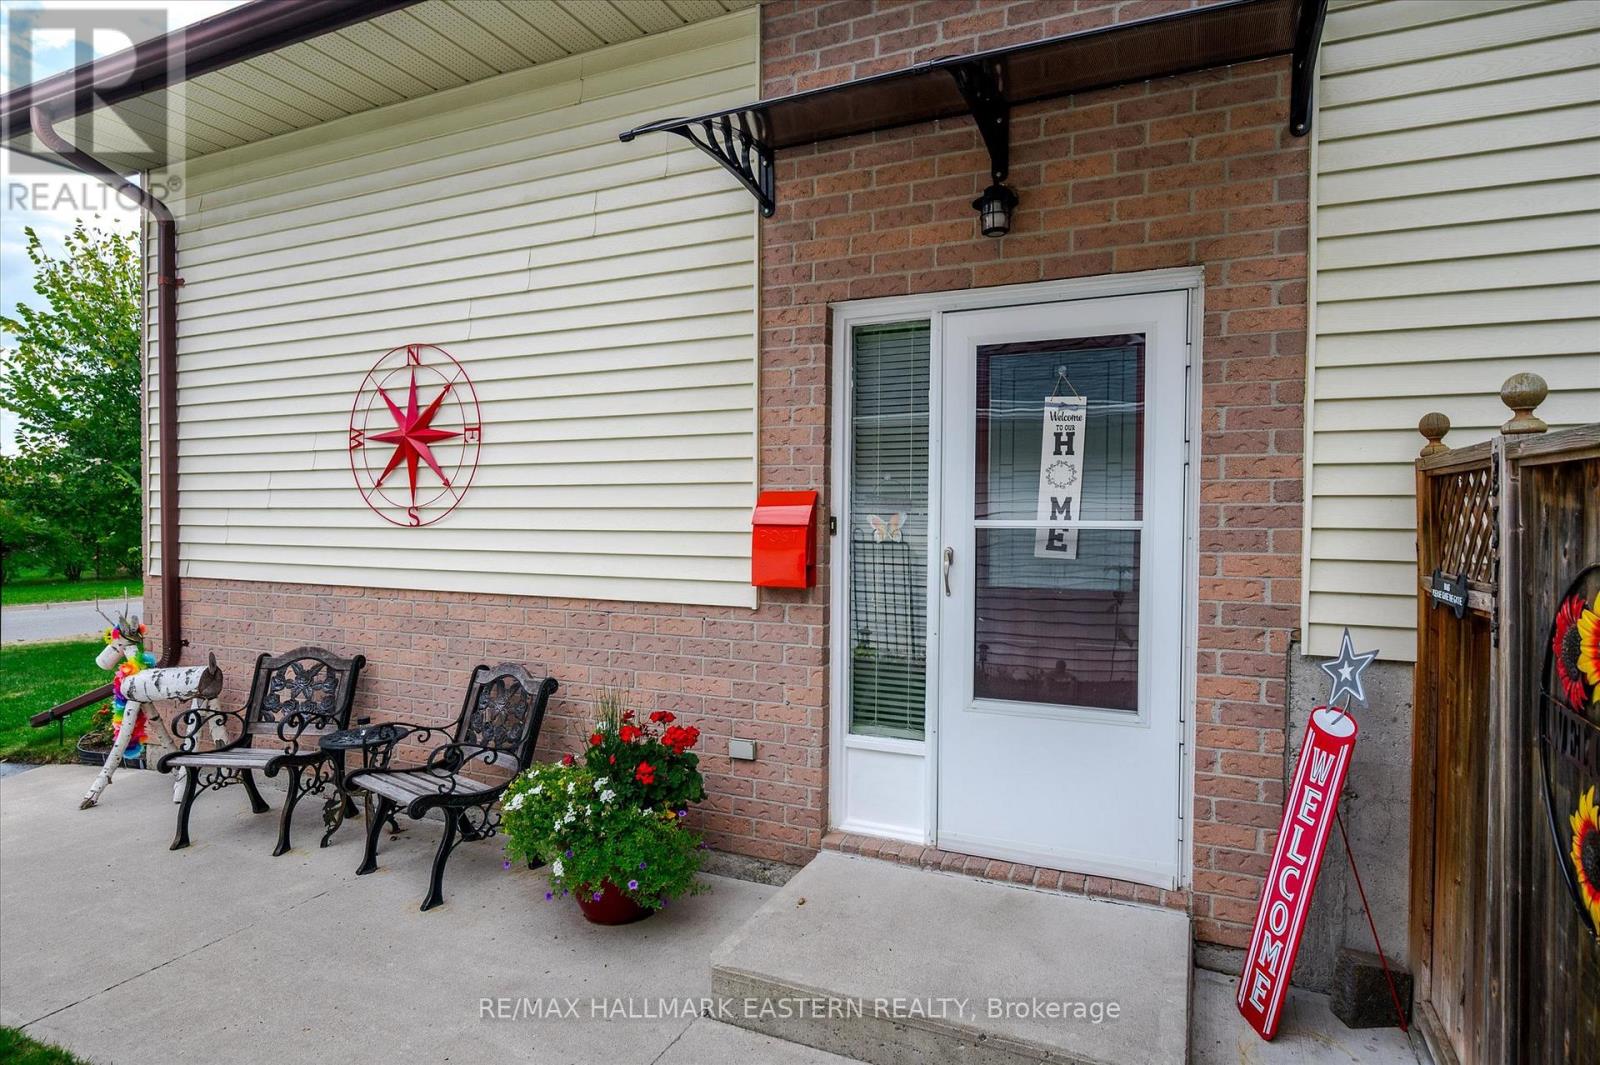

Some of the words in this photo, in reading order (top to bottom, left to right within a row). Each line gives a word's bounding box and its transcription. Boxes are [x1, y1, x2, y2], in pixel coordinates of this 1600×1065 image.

[406, 345, 421, 366] N
[1049, 410, 1083, 422] Welcome
[350, 427, 366, 451] W
[464, 427, 480, 444] E
[407, 506, 420, 527] S
[759, 528, 800, 545] POST
[1249, 747, 1335, 1013] WELCOME
